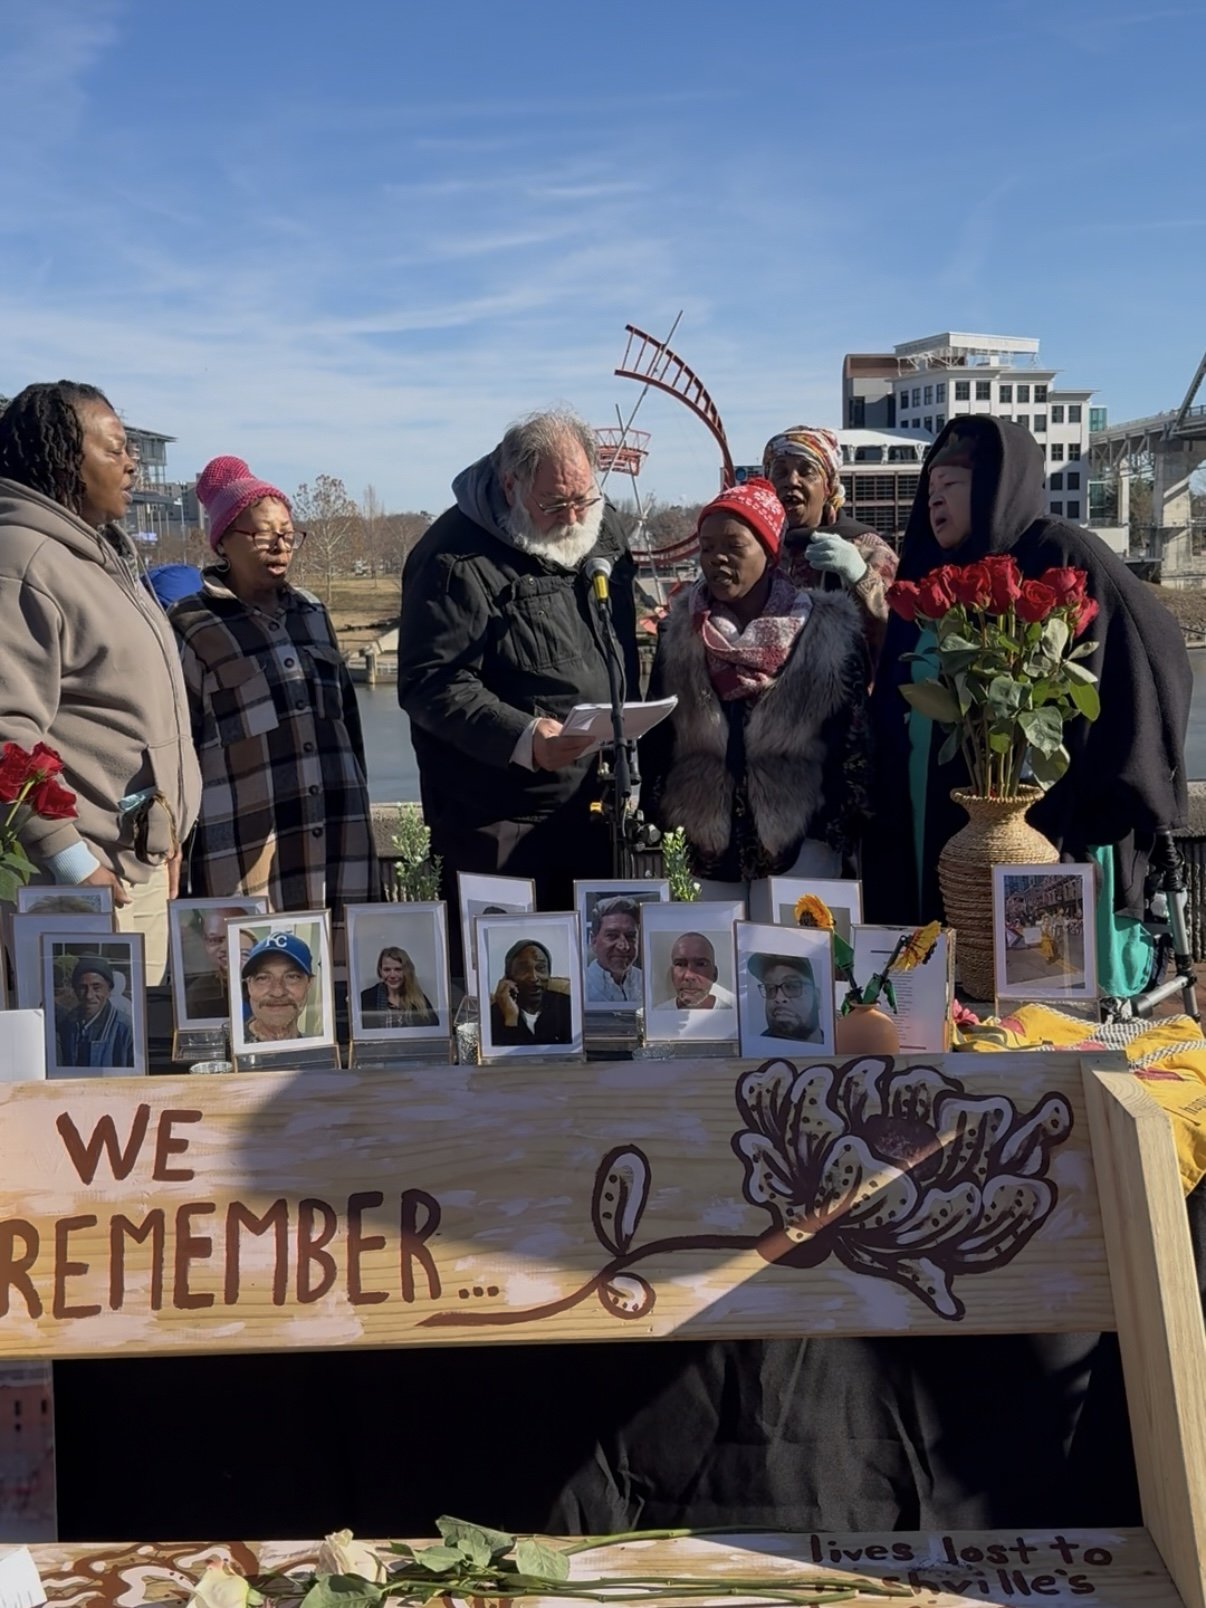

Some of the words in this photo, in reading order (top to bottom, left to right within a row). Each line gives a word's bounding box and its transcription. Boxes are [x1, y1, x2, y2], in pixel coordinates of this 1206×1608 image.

[56, 1104, 203, 1186] WE
[810, 1534, 914, 1564] lives
[942, 1536, 1038, 1565] lost
[1050, 1535, 1113, 1566] to
